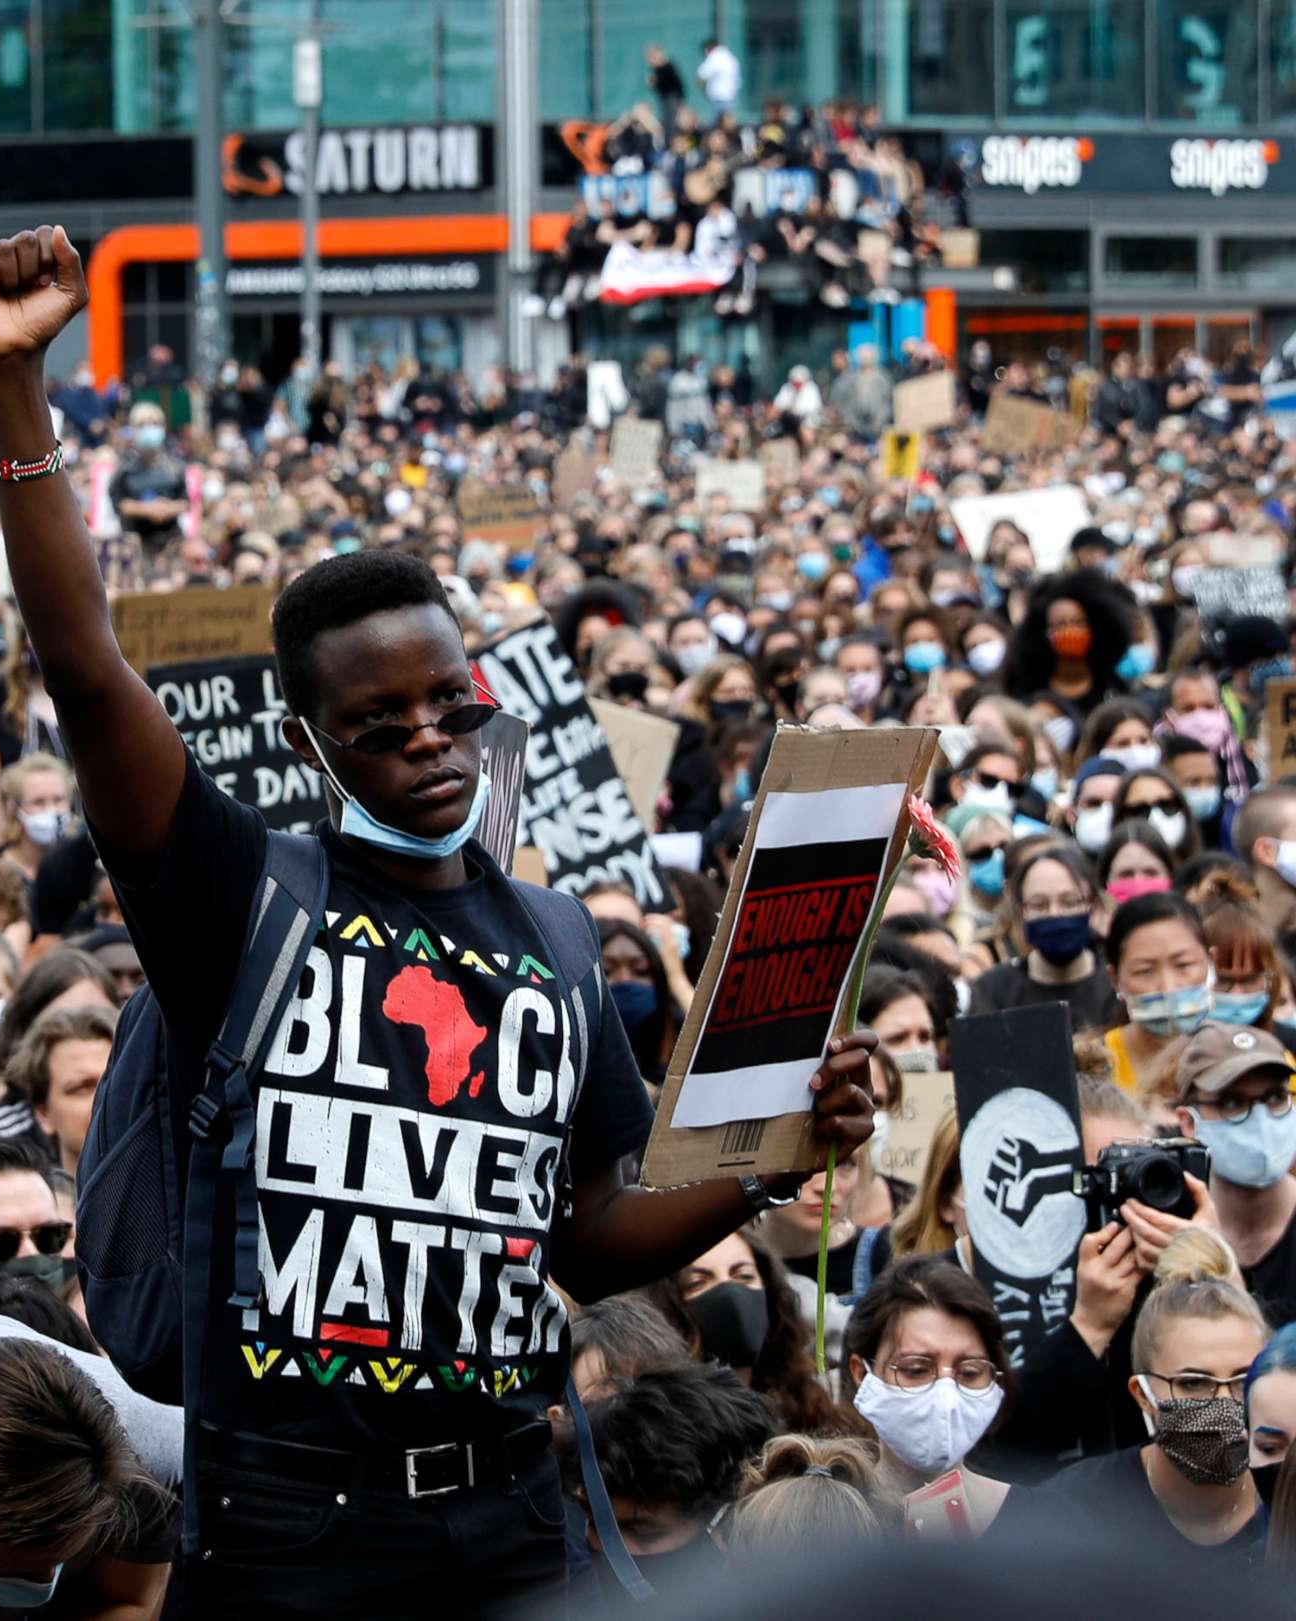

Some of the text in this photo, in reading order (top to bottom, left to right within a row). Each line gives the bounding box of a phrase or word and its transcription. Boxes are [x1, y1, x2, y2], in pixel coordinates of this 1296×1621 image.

[284, 125, 479, 195] SATURN
[982, 135, 1082, 194] snipes
[1171, 138, 1269, 197] snipes
[478, 623, 585, 726] ATE
[734, 889, 841, 955] ENOUGH
[263, 1096, 559, 1222] LIVES
